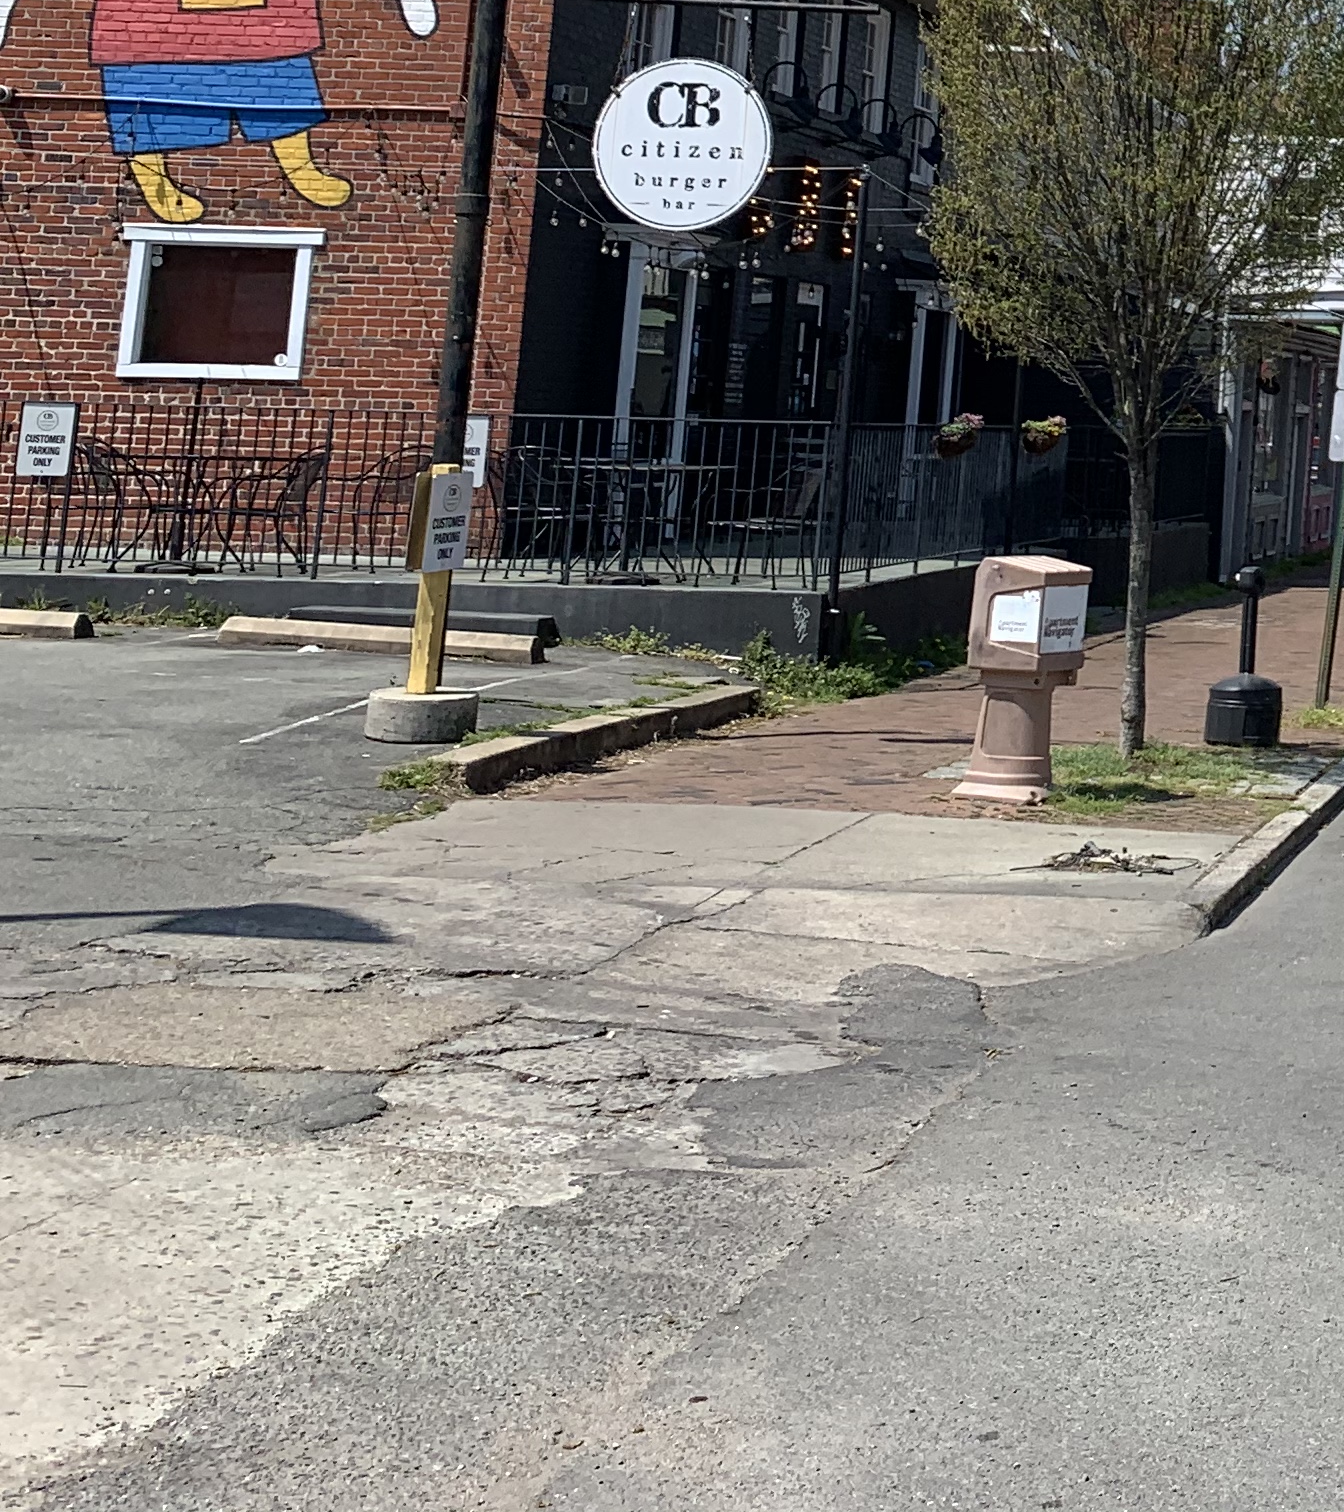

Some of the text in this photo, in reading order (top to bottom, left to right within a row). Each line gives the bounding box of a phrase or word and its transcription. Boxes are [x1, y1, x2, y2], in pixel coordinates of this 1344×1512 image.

[647, 81, 721, 128] CB
[621, 140, 744, 160] citizen
[633, 172, 728, 192] burger
[662, 198, 696, 210] bar
[25, 434, 66, 443] CUSTOMER
[27, 446, 61, 455] PARKING
[33, 457, 53, 467] ONLY
[432, 515, 466, 530] CUSTOMER
[433, 531, 461, 545] PARKING
[437, 547, 454, 560] ONLY
